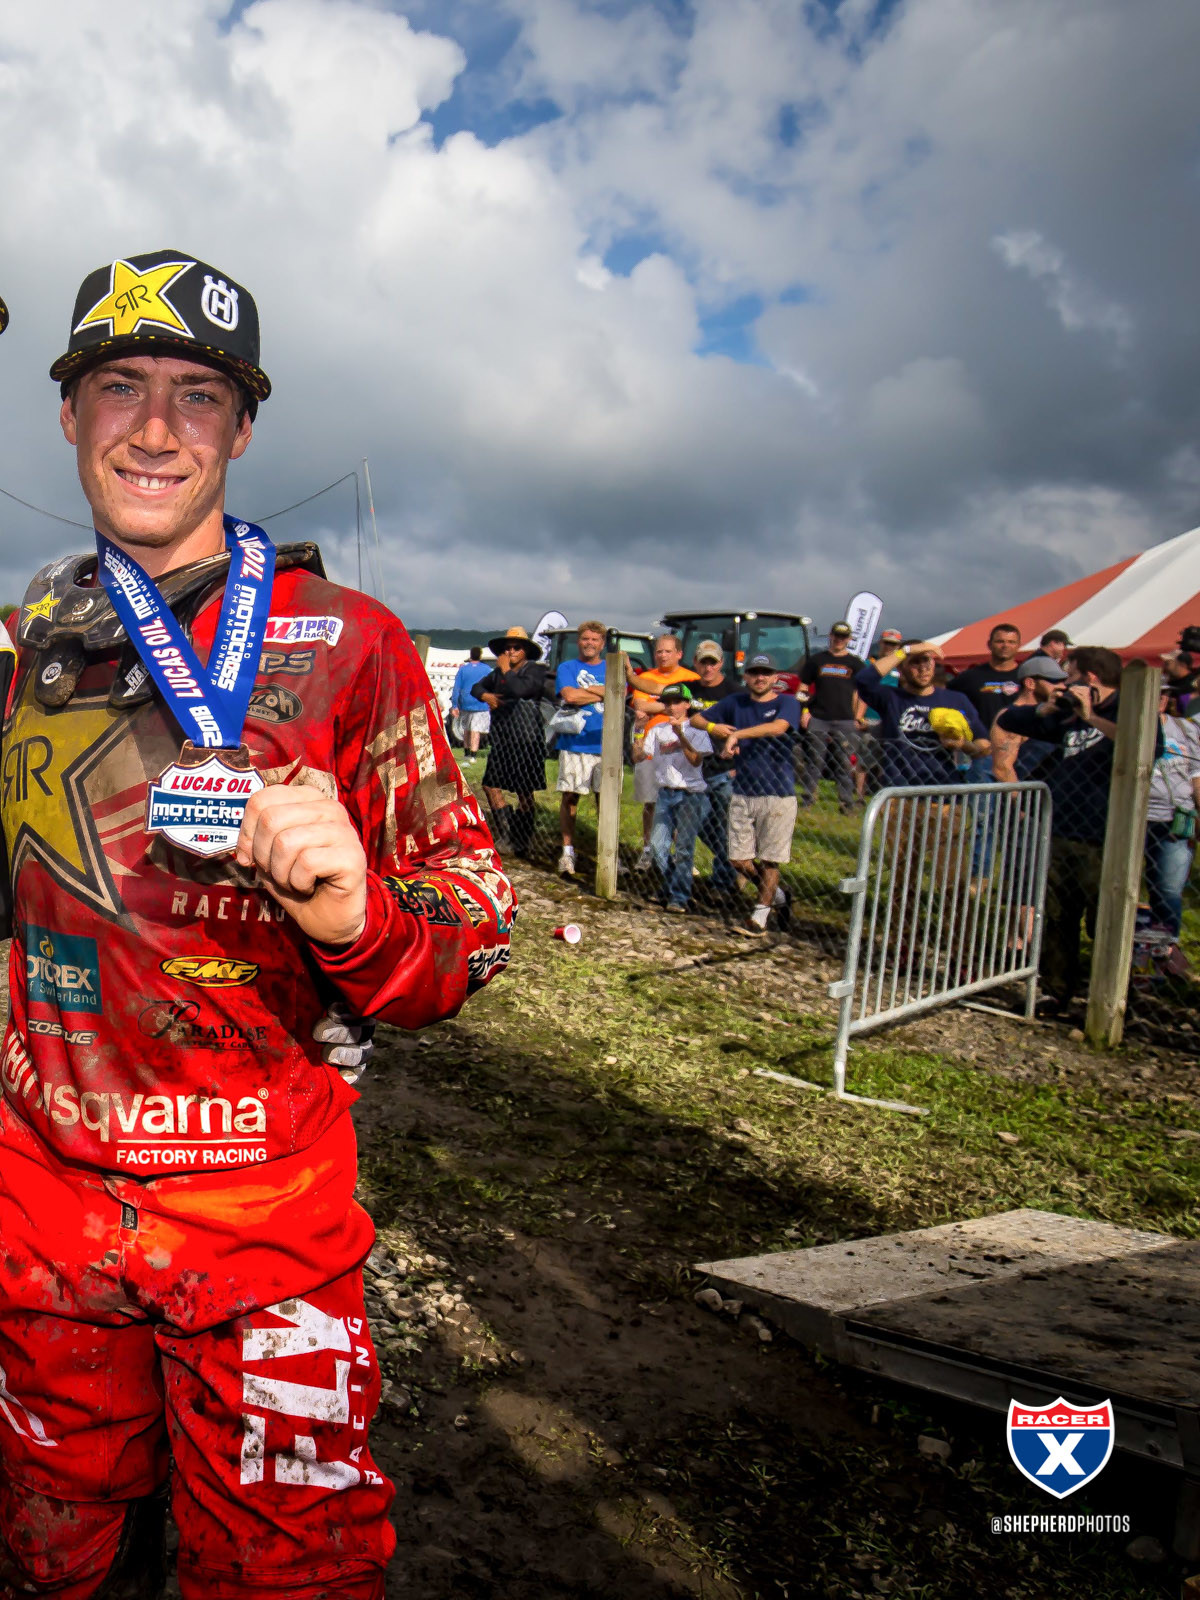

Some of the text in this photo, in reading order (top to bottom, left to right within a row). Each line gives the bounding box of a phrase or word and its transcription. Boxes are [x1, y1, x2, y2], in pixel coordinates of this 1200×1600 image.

[104, 552, 154, 620] MOTOCROSS
[105, 546, 160, 612] CHAMPIONSHIP
[210, 583, 257, 693] PRO MOTOCROSS CHAMPIONSHIP
[305, 620, 337, 634] PRO
[152, 646, 205, 699] LUCAS
[189, 705, 223, 748] 2018
[171, 775, 253, 793] LUCAS OIL
[164, 960, 258, 980] FMF
[116, 1148, 268, 1164] FACTORY RACING
[347, 1316, 384, 1485] RACING
